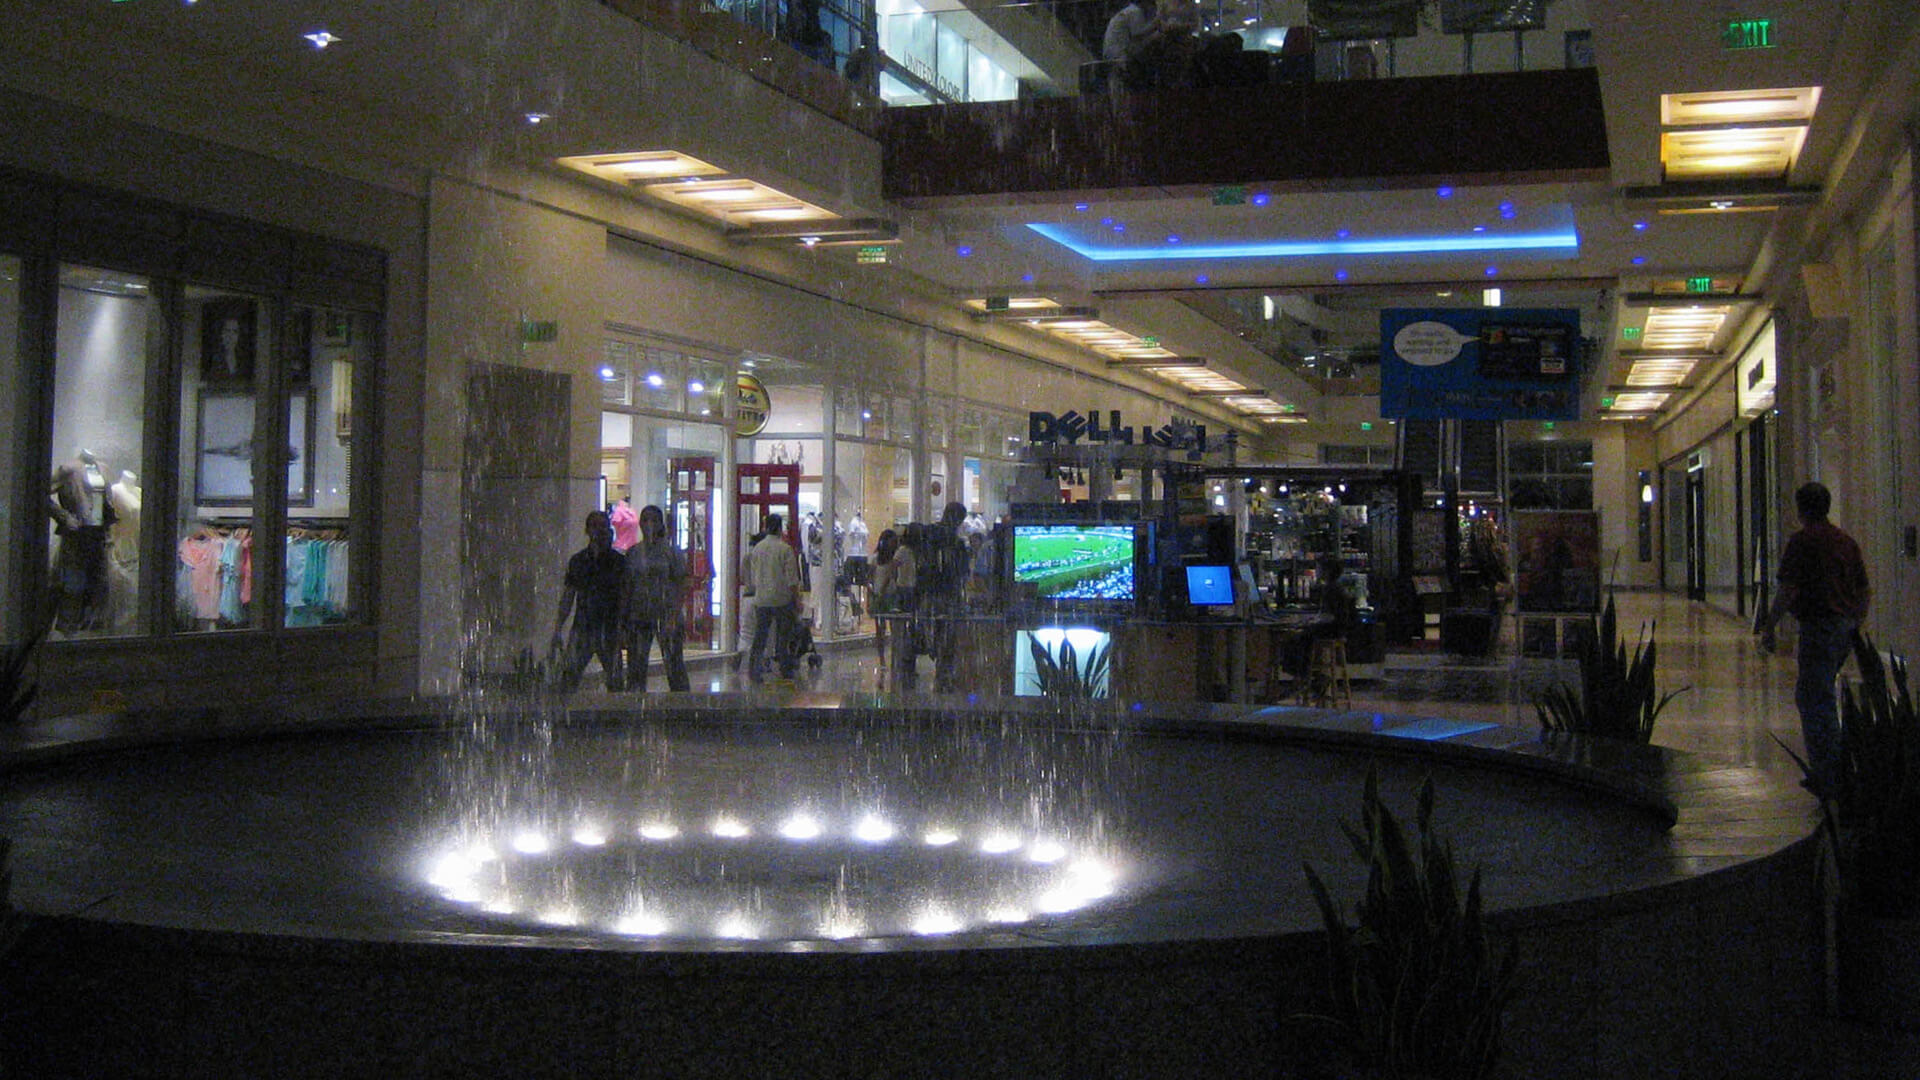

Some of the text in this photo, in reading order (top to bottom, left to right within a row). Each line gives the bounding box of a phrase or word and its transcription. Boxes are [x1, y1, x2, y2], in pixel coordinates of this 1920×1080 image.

[1729, 21, 1769, 47] EXIT
[904, 50, 934, 84] UNITED
[1687, 277, 1711, 293] EXIT
[1029, 410, 1132, 446] DELL
